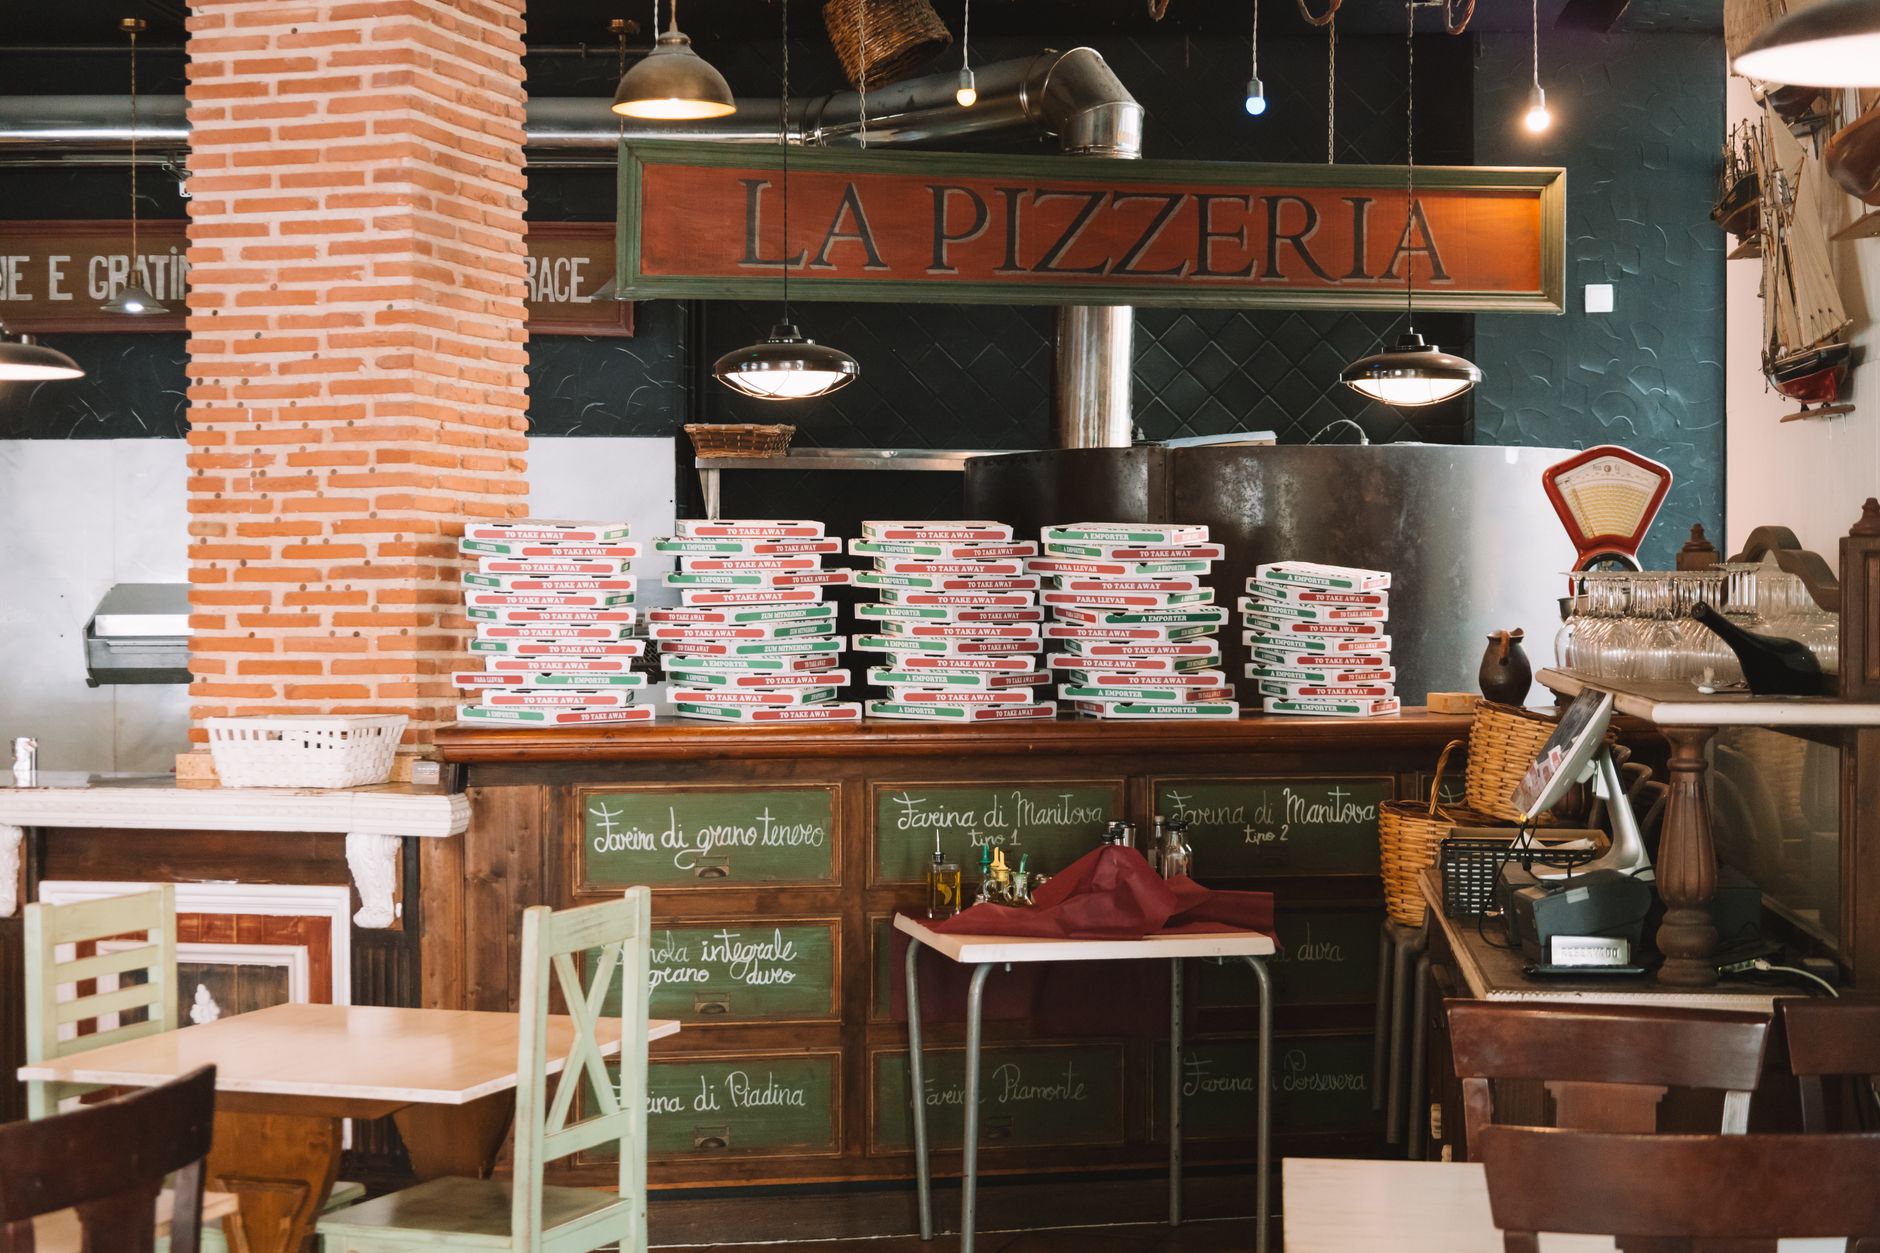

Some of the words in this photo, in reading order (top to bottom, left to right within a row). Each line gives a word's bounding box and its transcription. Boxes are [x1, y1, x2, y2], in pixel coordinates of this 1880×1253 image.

[738, 179, 890, 271] LA
[925, 184, 1454, 285] PIZZERIA
[49, 255, 73, 301] E
[1295, 575, 1330, 586] EMPORTER
[589, 802, 657, 853] Farina
[661, 806, 689, 848] di
[756, 806, 825, 847] tenero
[892, 791, 977, 830] Farina
[983, 794, 1009, 828] di
[1166, 790, 1247, 826] Farina
[1253, 789, 1275, 825] di
[674, 824, 758, 870] grano
[1009, 828, 1022, 846] 1
[1279, 824, 1289, 841] 2
[700, 928, 797, 980] integrale
[1297, 921, 1344, 962] dura
[746, 959, 796, 985] duro
[693, 1074, 720, 1111] di
[725, 1070, 806, 1108] Piadina
[1183, 1051, 1253, 1097] Farina
